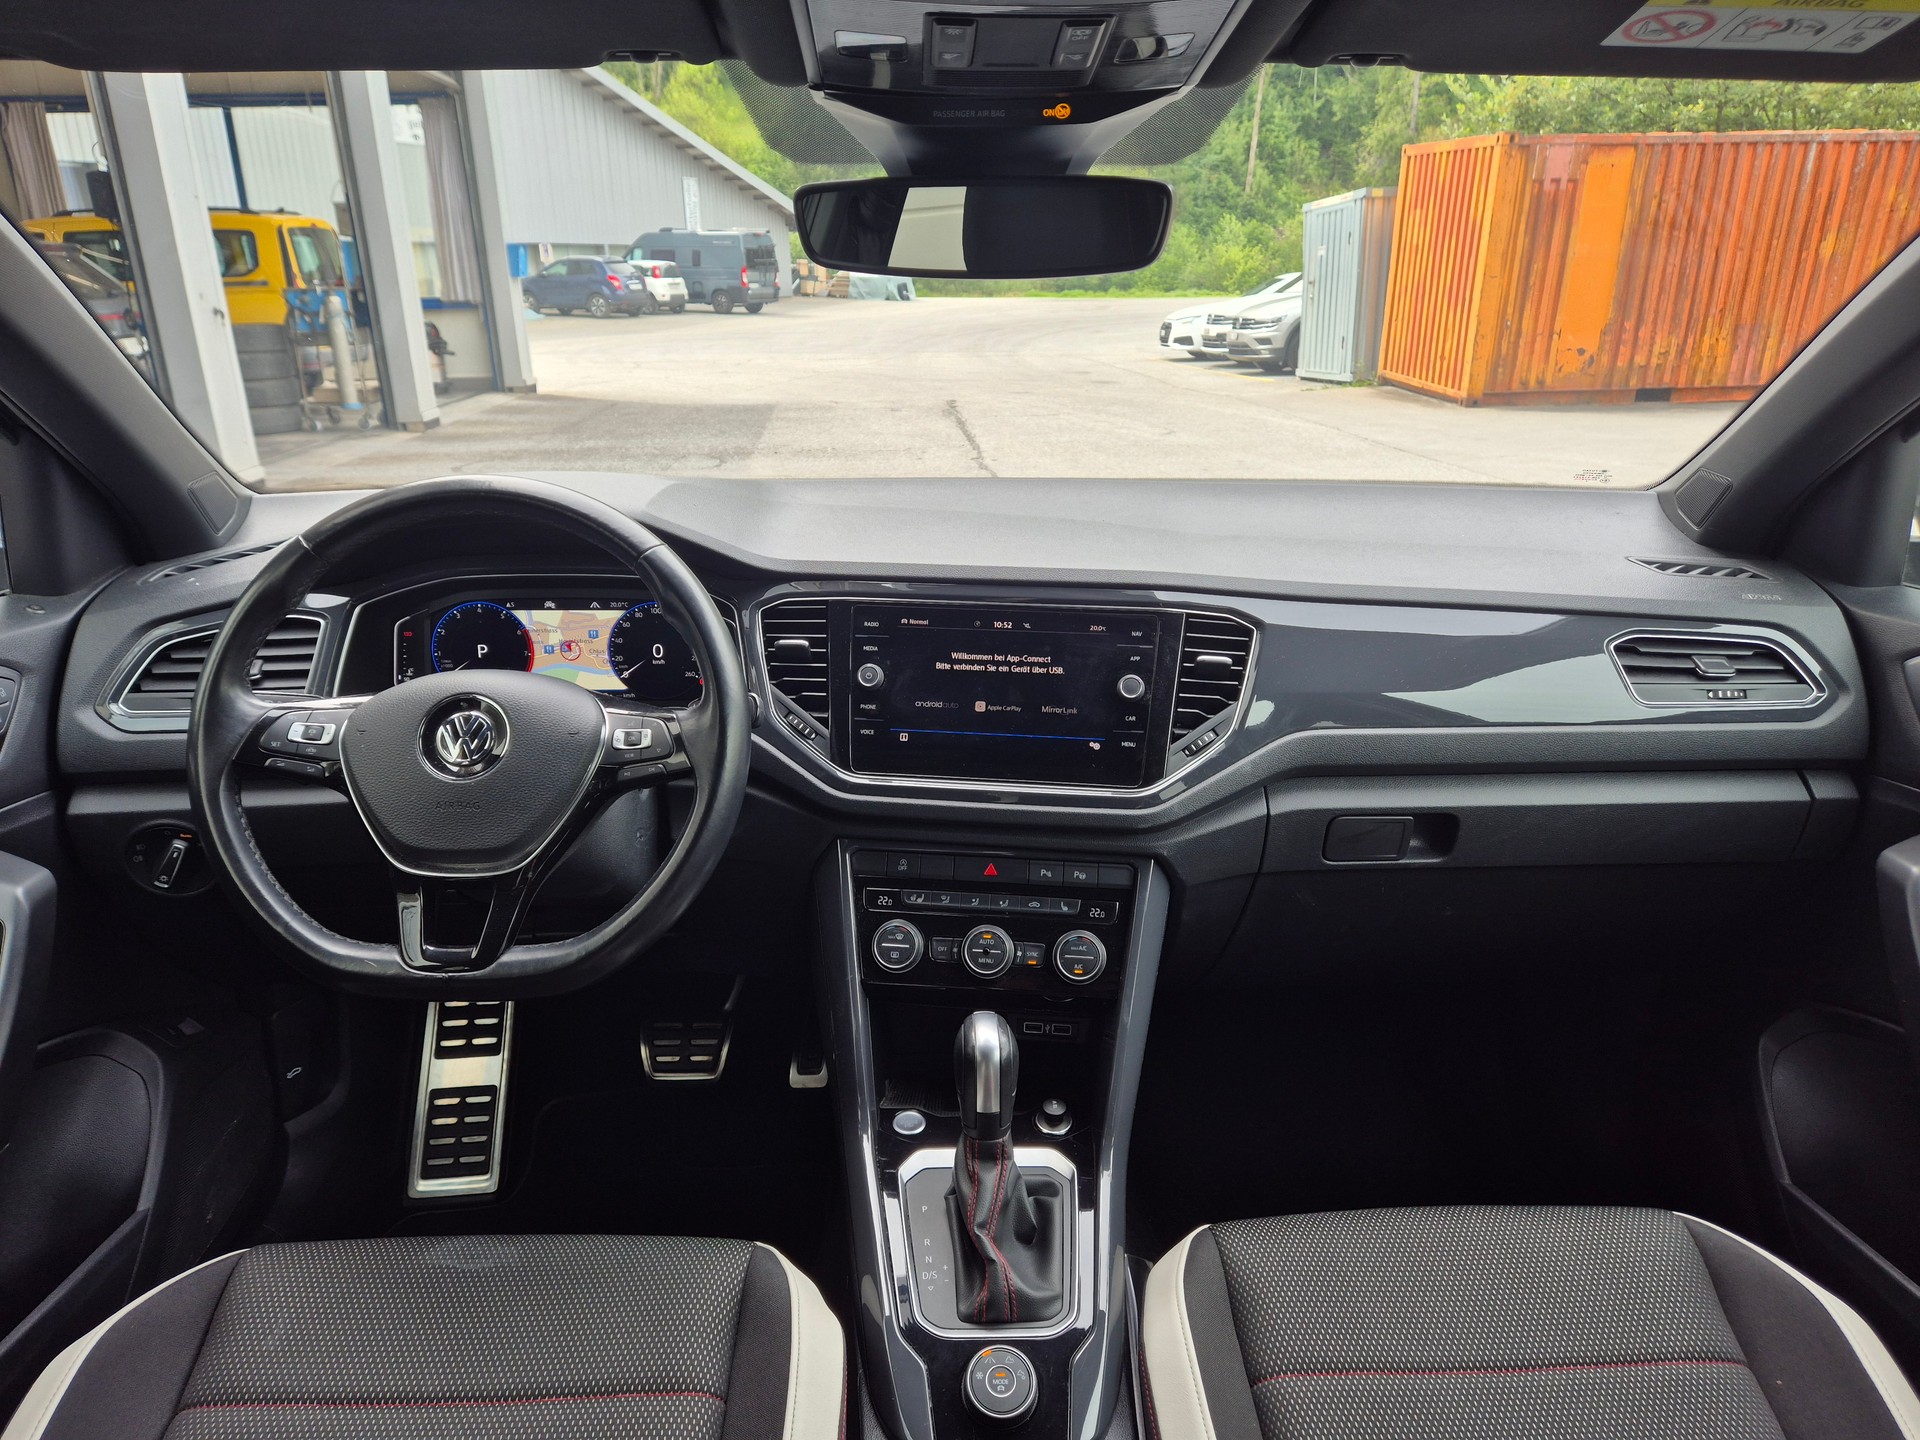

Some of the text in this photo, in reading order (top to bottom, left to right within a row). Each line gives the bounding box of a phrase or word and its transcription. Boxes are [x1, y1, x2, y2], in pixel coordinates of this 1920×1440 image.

[932, 109, 1006, 118] PASSENGER AIR BAG
[650, 607, 662, 615] 100
[993, 621, 1013, 629] 10:52
[477, 644, 488, 658] P
[652, 644, 664, 658] 0
[951, 651, 1051, 663] Willkommen bei App-Connect
[935, 662, 951, 670] Bitte
[953, 662, 985, 671] verbinden
[986, 663, 997, 672] Sie
[1011, 665, 1030, 673] Gerät
[1031, 666, 1047, 674] über
[1048, 666, 1065, 674] USB.
[987, 704, 1002, 712] Apple
[1041, 705, 1078, 715] MirrorLink
[877, 895, 893, 906] 22.0
[1089, 908, 1106, 918] 22.0
[921, 1205, 928, 1213] P
[924, 1238, 931, 1246] R
[925, 1255, 932, 1264] N
[922, 1270, 938, 1280] D/S
